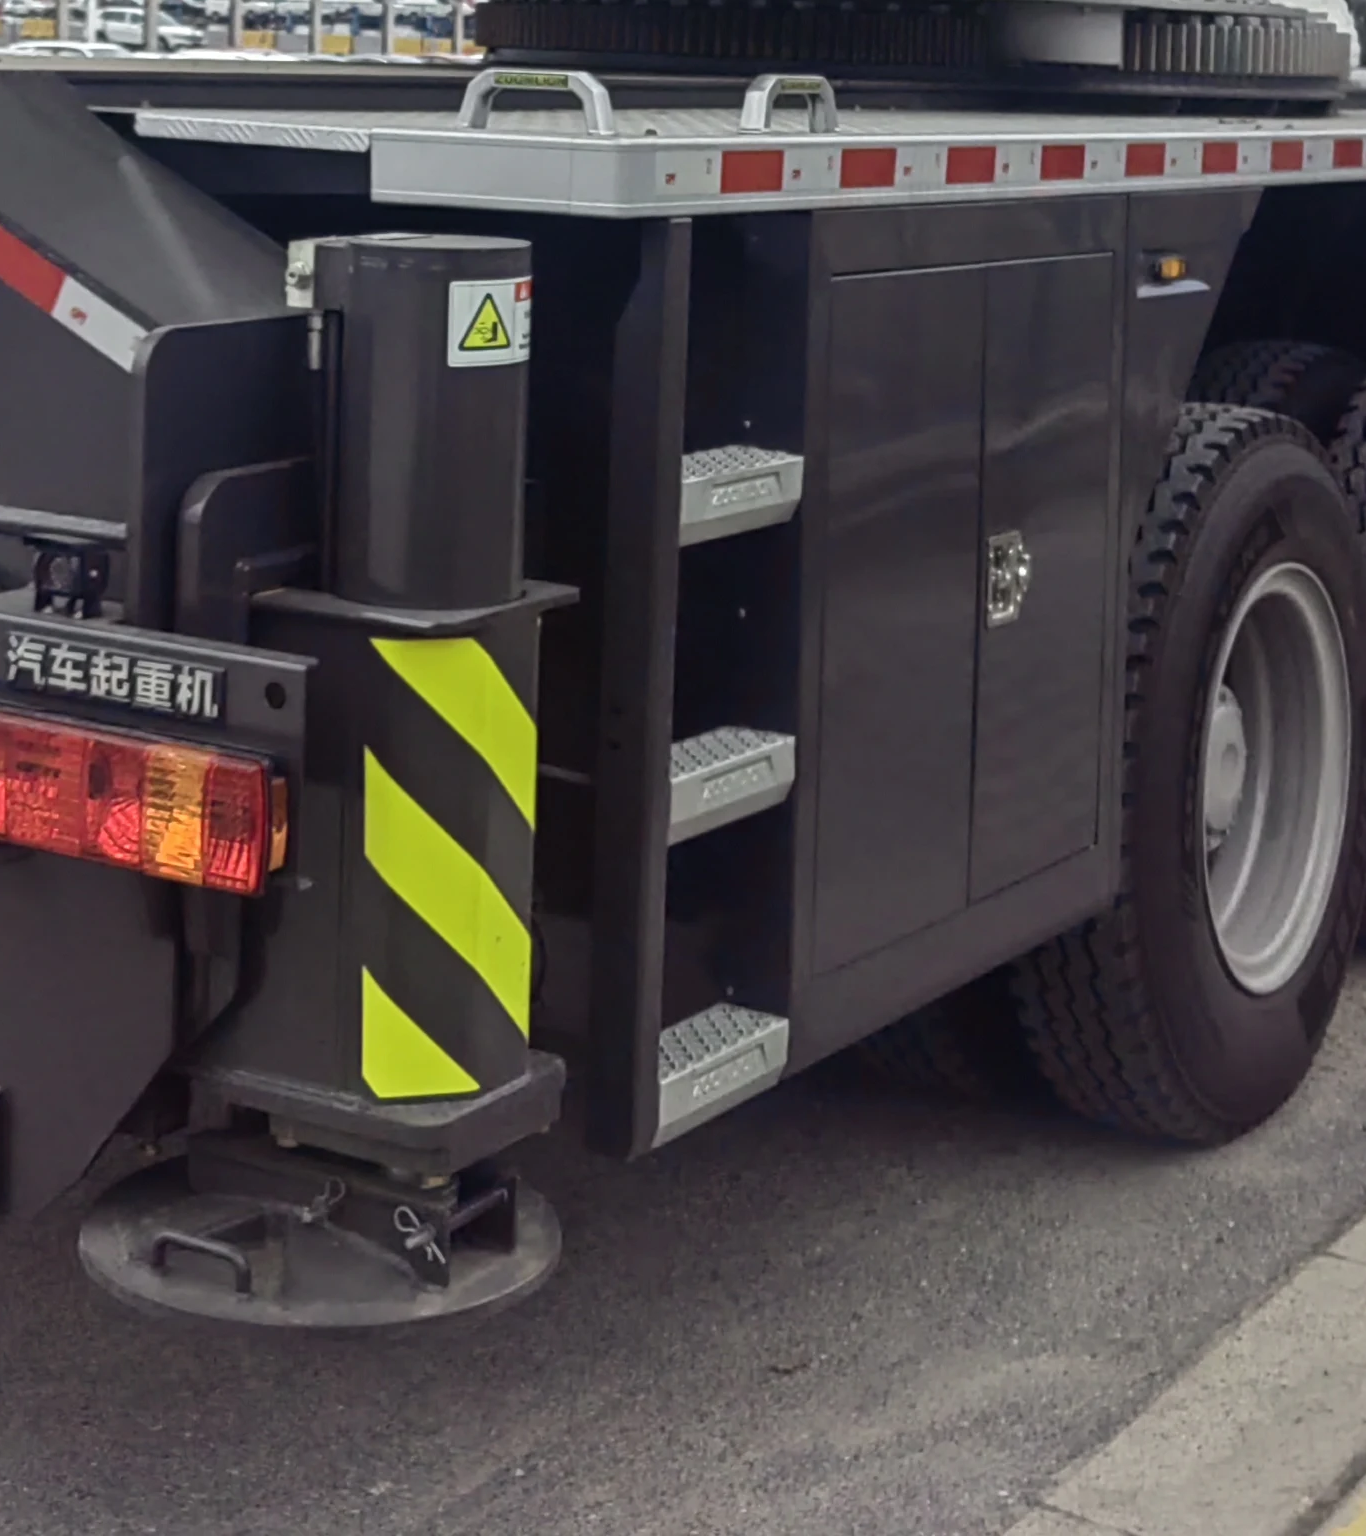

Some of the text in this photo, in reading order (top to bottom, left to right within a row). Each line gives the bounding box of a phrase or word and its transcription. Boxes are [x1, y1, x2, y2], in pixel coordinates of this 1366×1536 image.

[7, 634, 218, 717] 汽车起重机
